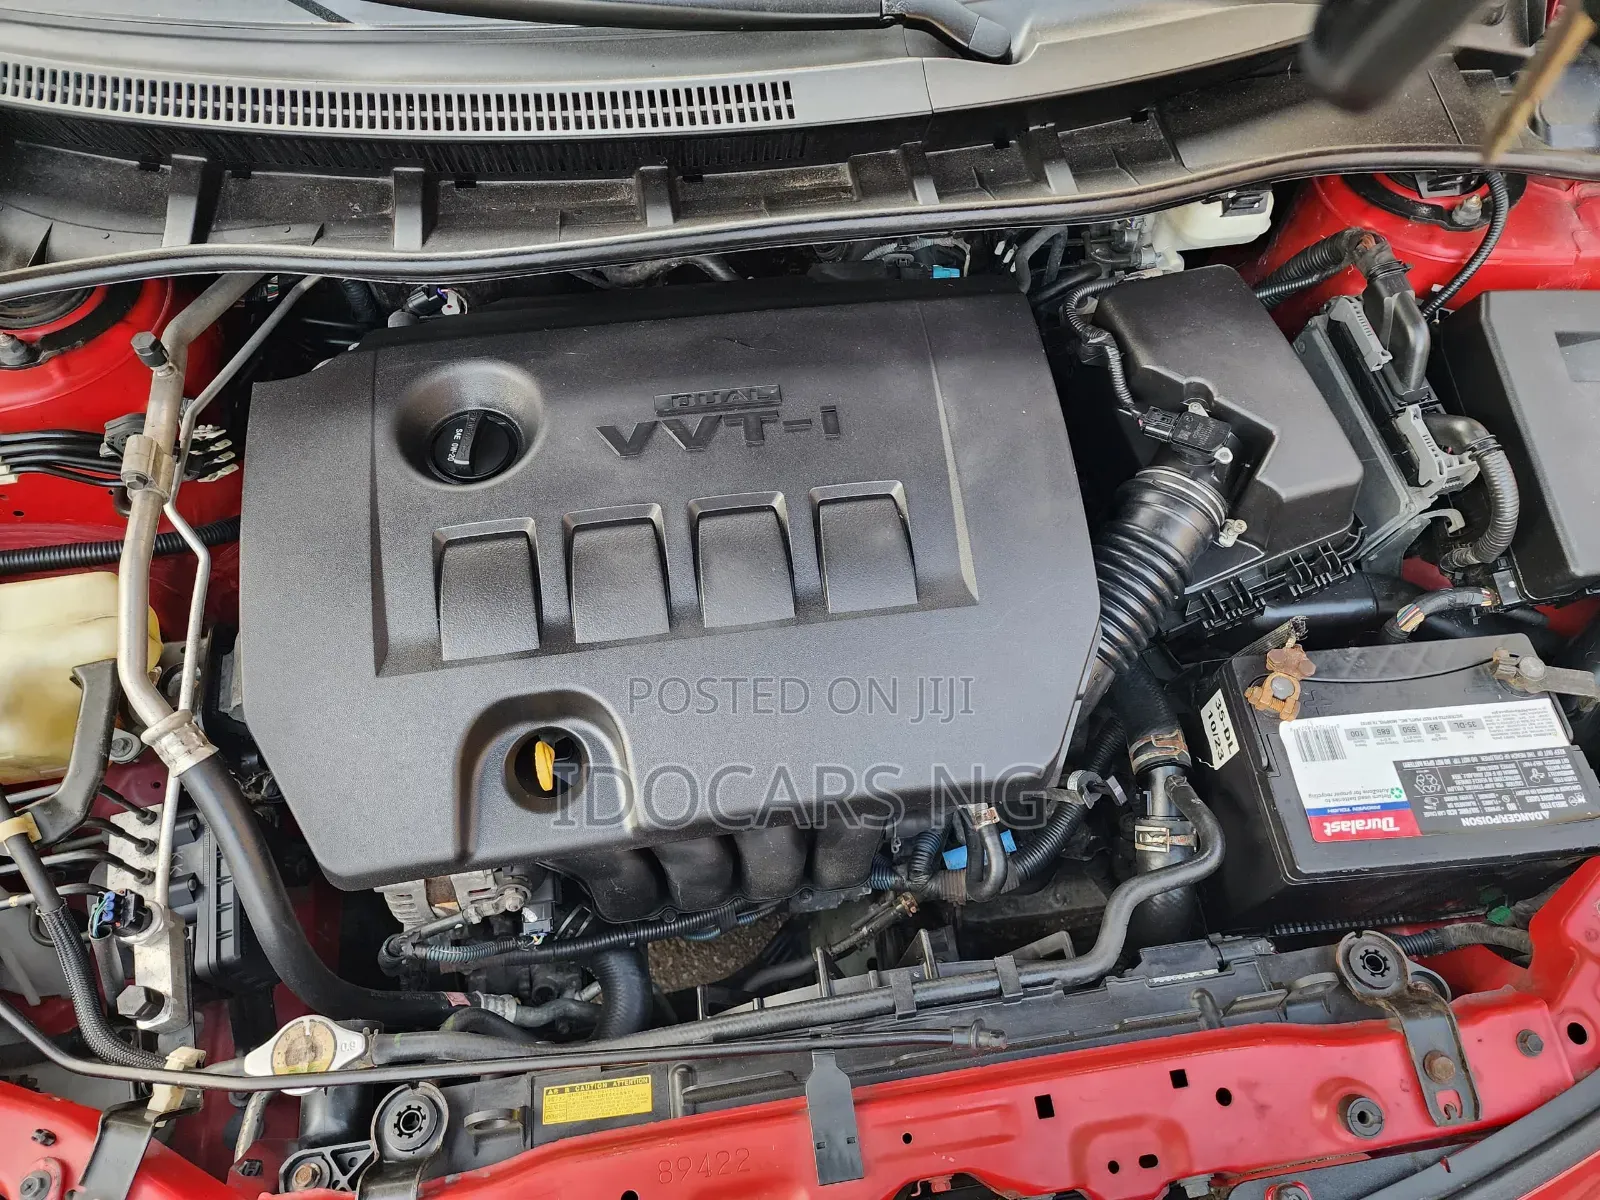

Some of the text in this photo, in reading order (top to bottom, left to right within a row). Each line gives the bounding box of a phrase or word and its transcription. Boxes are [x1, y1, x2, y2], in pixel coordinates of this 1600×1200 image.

[447, 428, 462, 461] SAE 0W-20
[1215, 698, 1233, 755] 35-DL
[1375, 727, 1390, 735] 685
[1428, 723, 1439, 731] 35
[1452, 720, 1476, 729] 35-DL
[1207, 711, 1225, 760] 10/23
[1350, 729, 1364, 737] 100
[1323, 816, 1401, 837] Duralast
[1461, 812, 1541, 827] DANGER/POISON
[575, 1082, 608, 1092] CAUTION
[613, 1077, 648, 1088] ATTENTION
[658, 1147, 751, 1184] 89422
